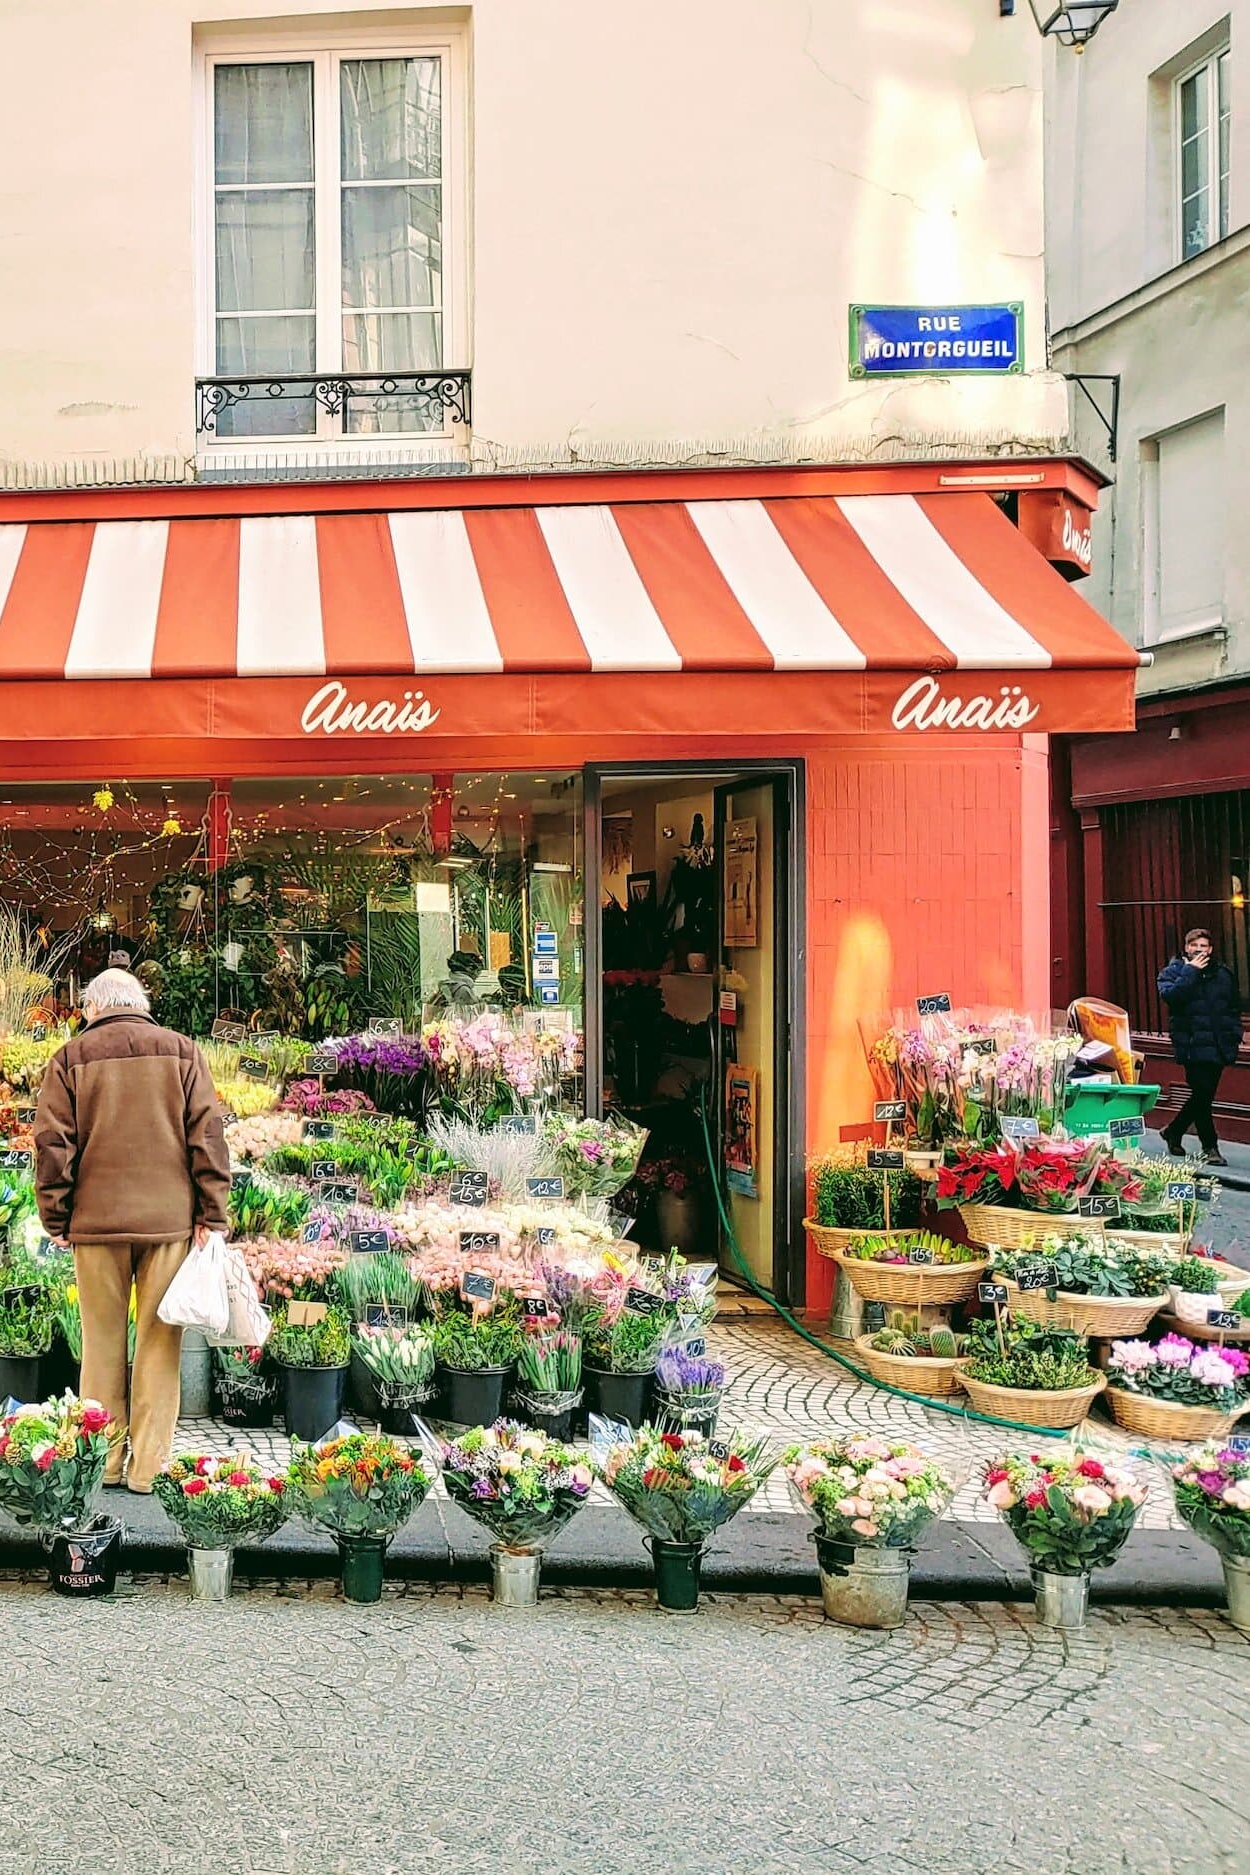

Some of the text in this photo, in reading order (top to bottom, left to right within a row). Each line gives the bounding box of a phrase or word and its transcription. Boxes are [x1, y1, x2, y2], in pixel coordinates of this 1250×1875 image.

[918, 315, 961, 332] RUE
[864, 339, 1013, 361] MONTORGUEIL
[301, 681, 441, 734] Anaïs
[891, 675, 1039, 731] Anaïs
[312, 1056, 336, 1071] 8€
[315, 1163, 334, 1178] 6€
[451, 1185, 487, 1202] 15€
[529, 1179, 561, 1195] 12€
[1170, 1185, 1193, 1201] 20€
[1080, 1197, 1117, 1215] 15€
[358, 1232, 385, 1250] 5€
[461, 1233, 497, 1250] 10€
[984, 1285, 1005, 1300] 3€
[527, 1300, 545, 1314] 8€
